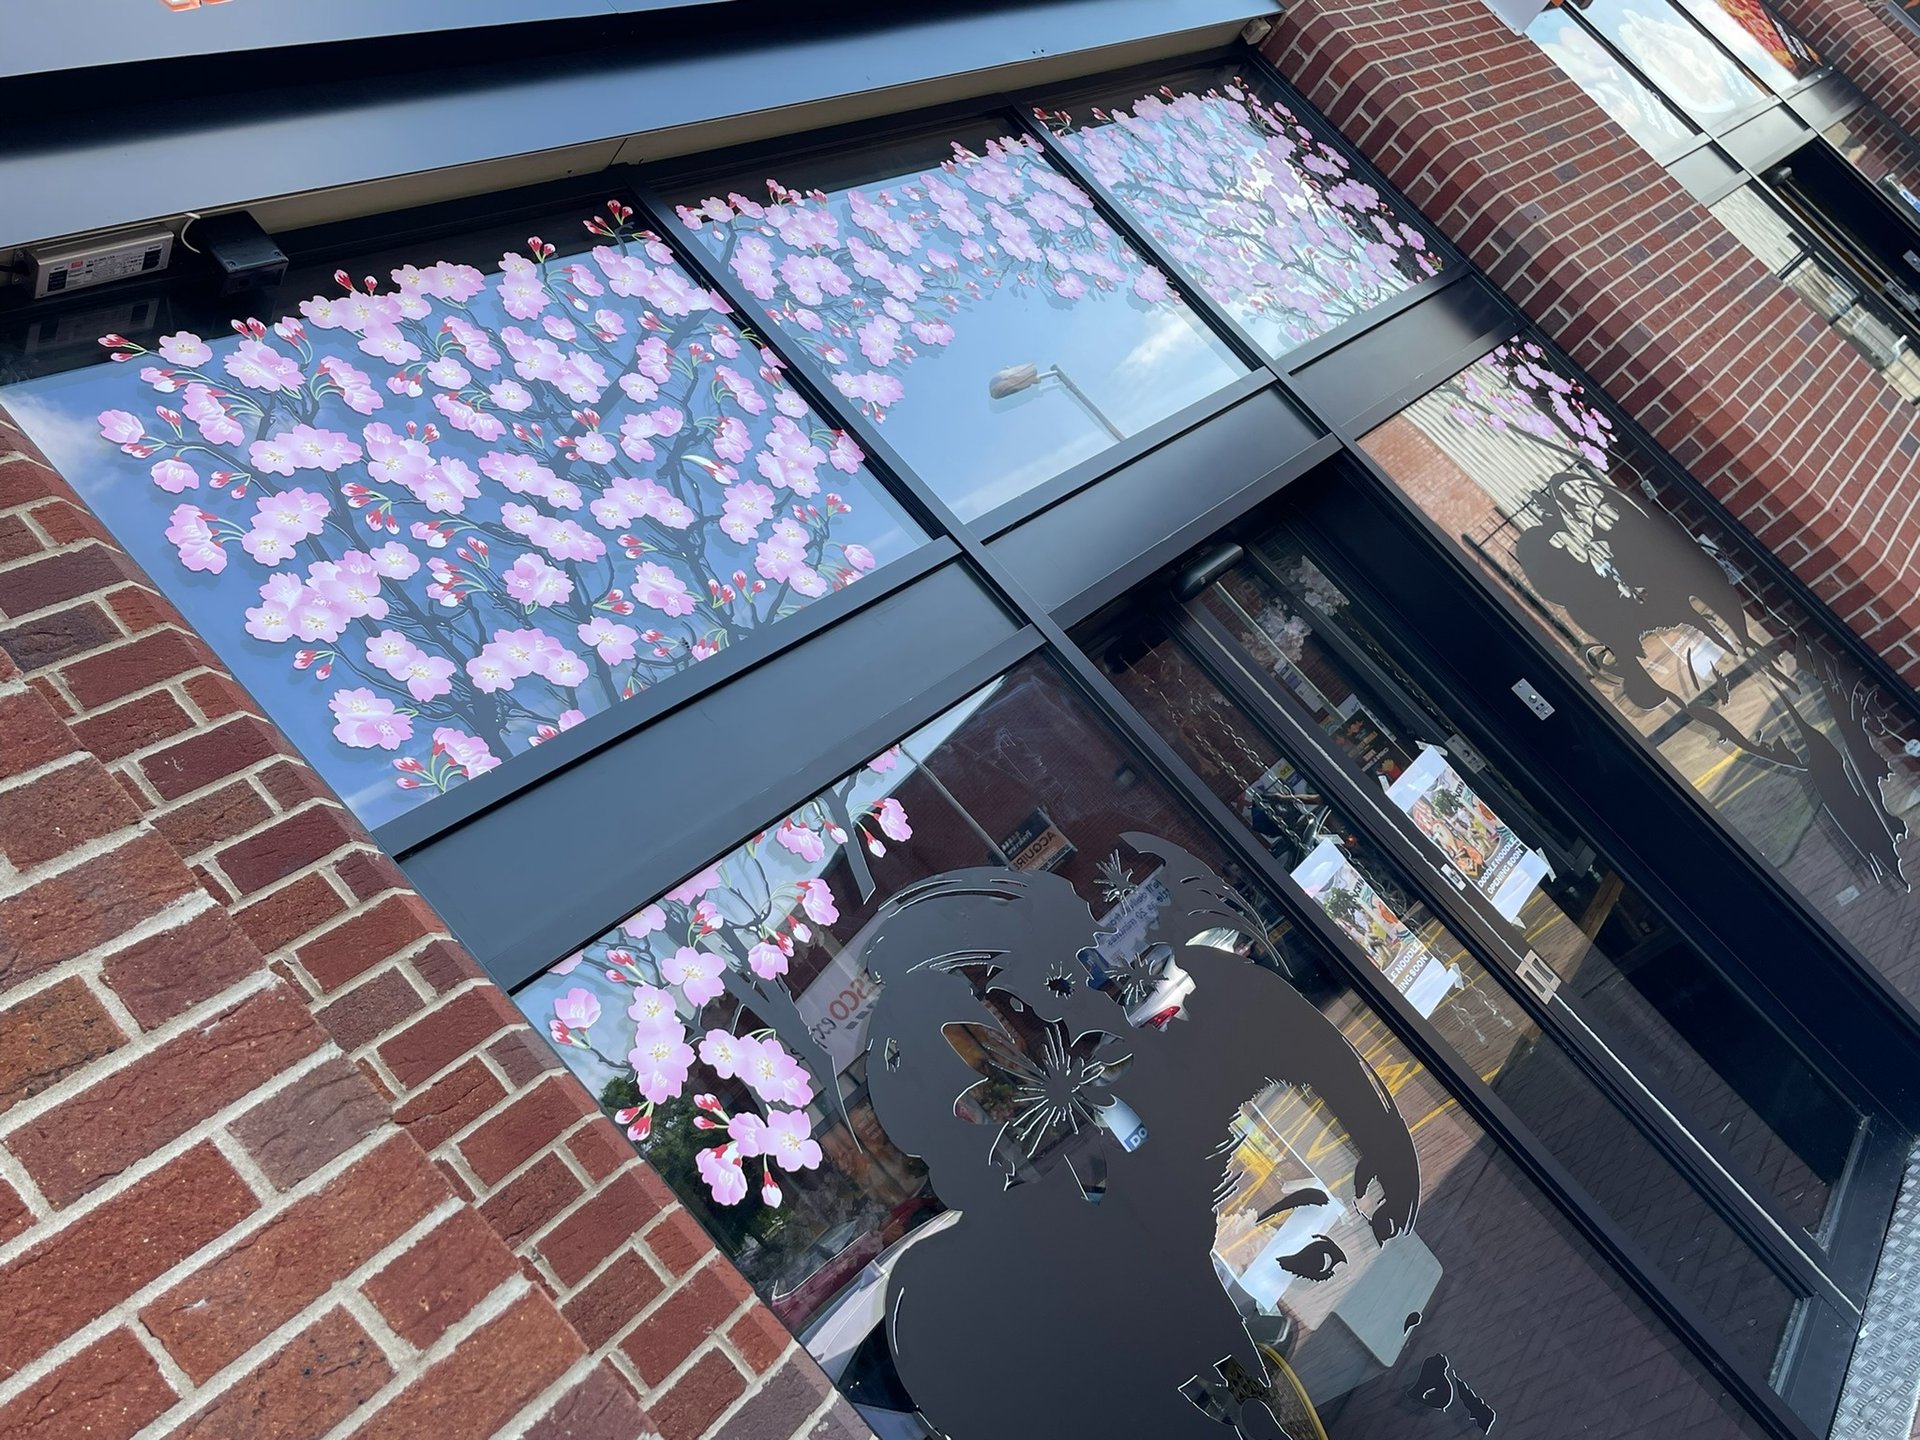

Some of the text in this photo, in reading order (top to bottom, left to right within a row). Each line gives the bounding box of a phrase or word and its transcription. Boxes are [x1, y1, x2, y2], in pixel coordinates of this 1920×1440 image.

[1487, 847, 1523, 894] OPENING SOON
[1408, 953, 1428, 977] SOON
